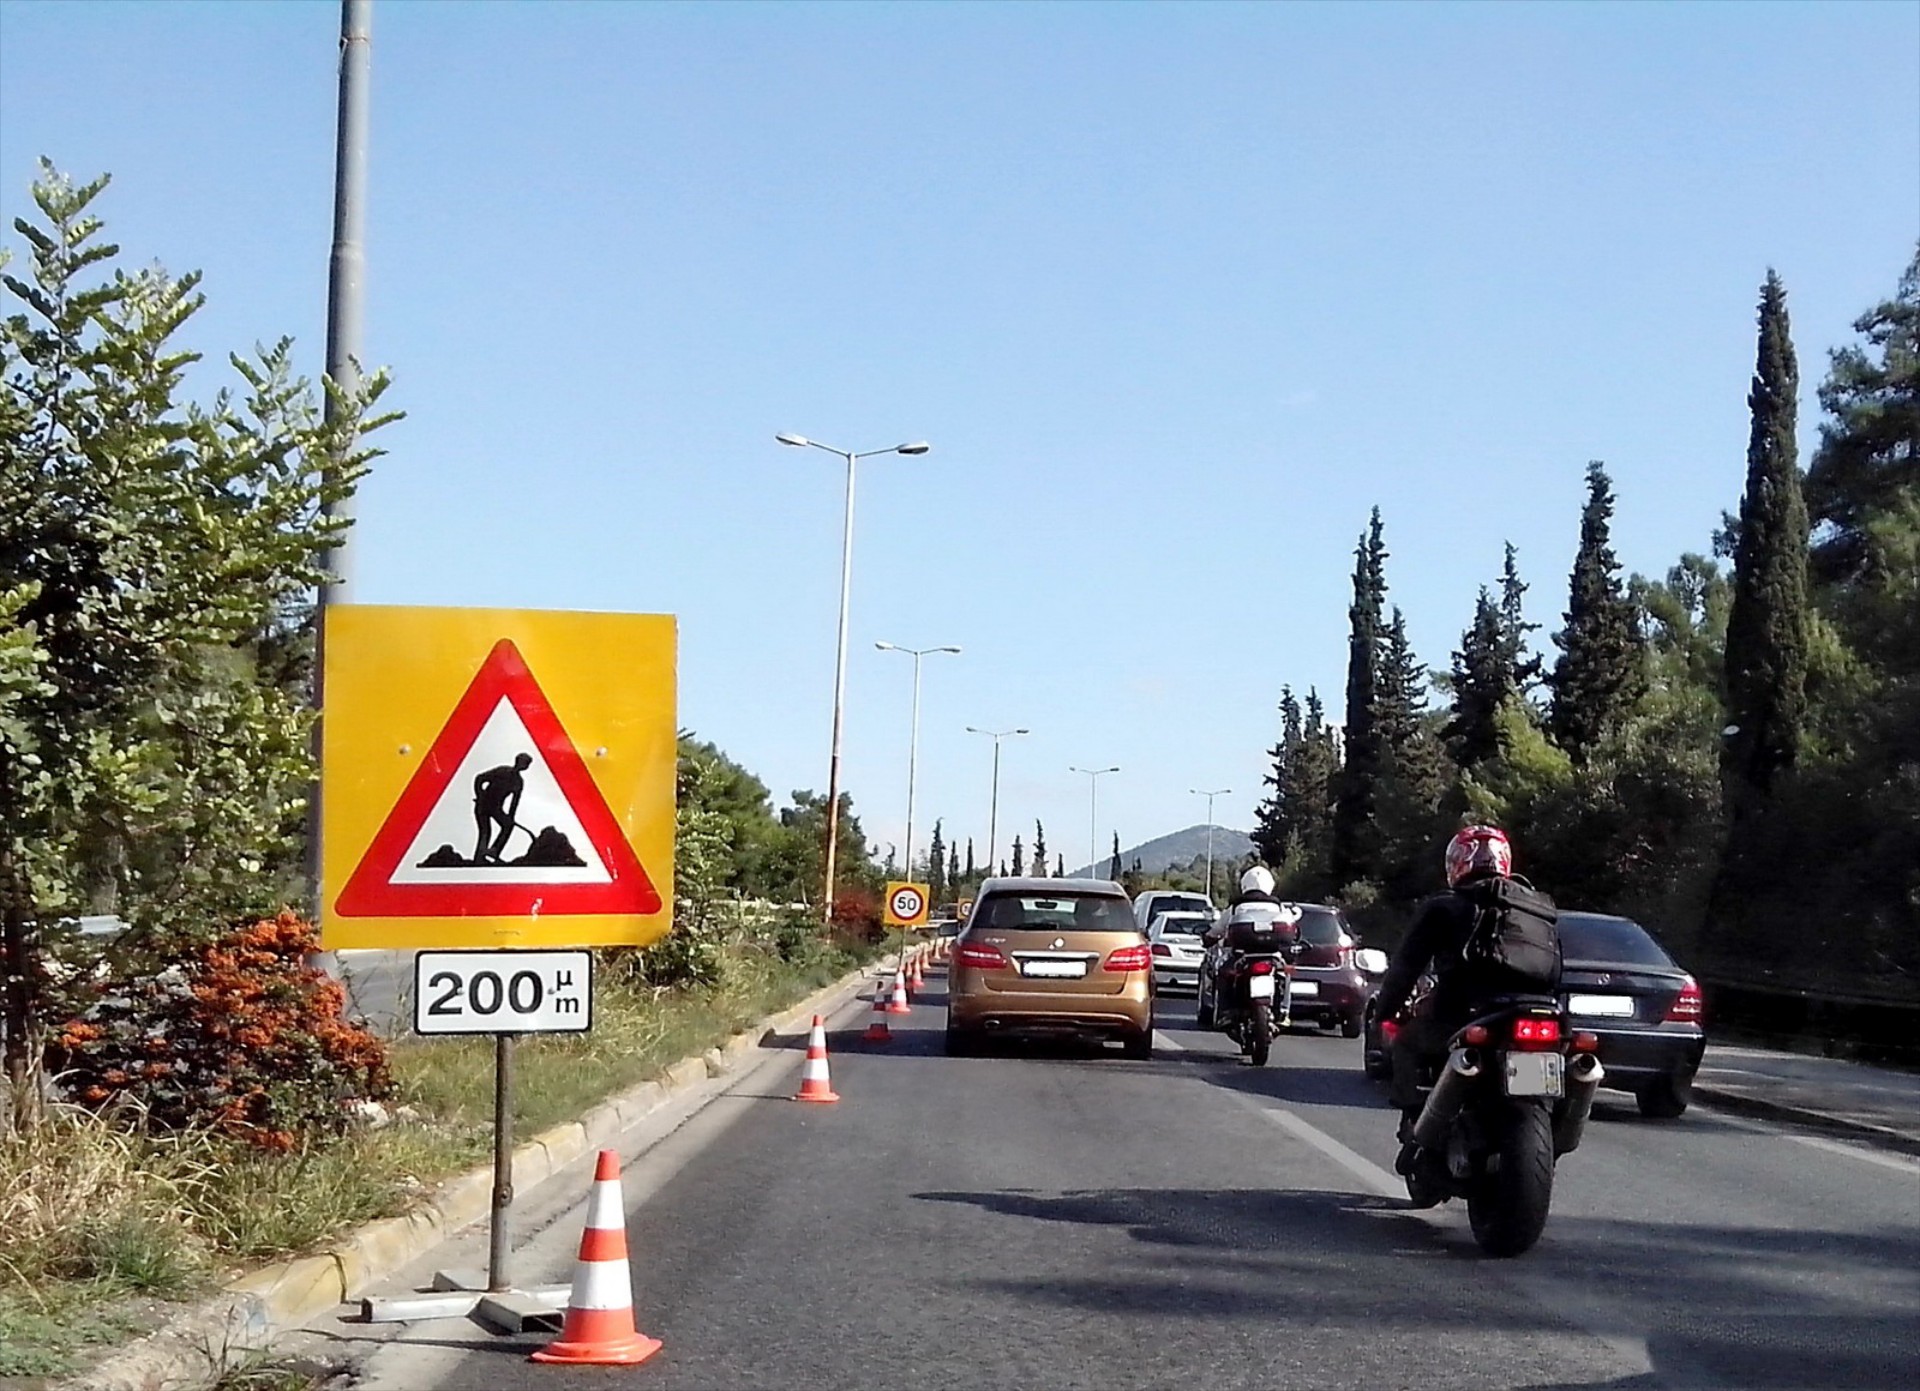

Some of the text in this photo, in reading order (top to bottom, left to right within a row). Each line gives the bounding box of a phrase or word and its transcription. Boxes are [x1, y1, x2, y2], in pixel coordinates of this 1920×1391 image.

[897, 896, 917, 910] 50
[428, 970, 543, 1015] 200
[555, 997, 579, 1013] m
